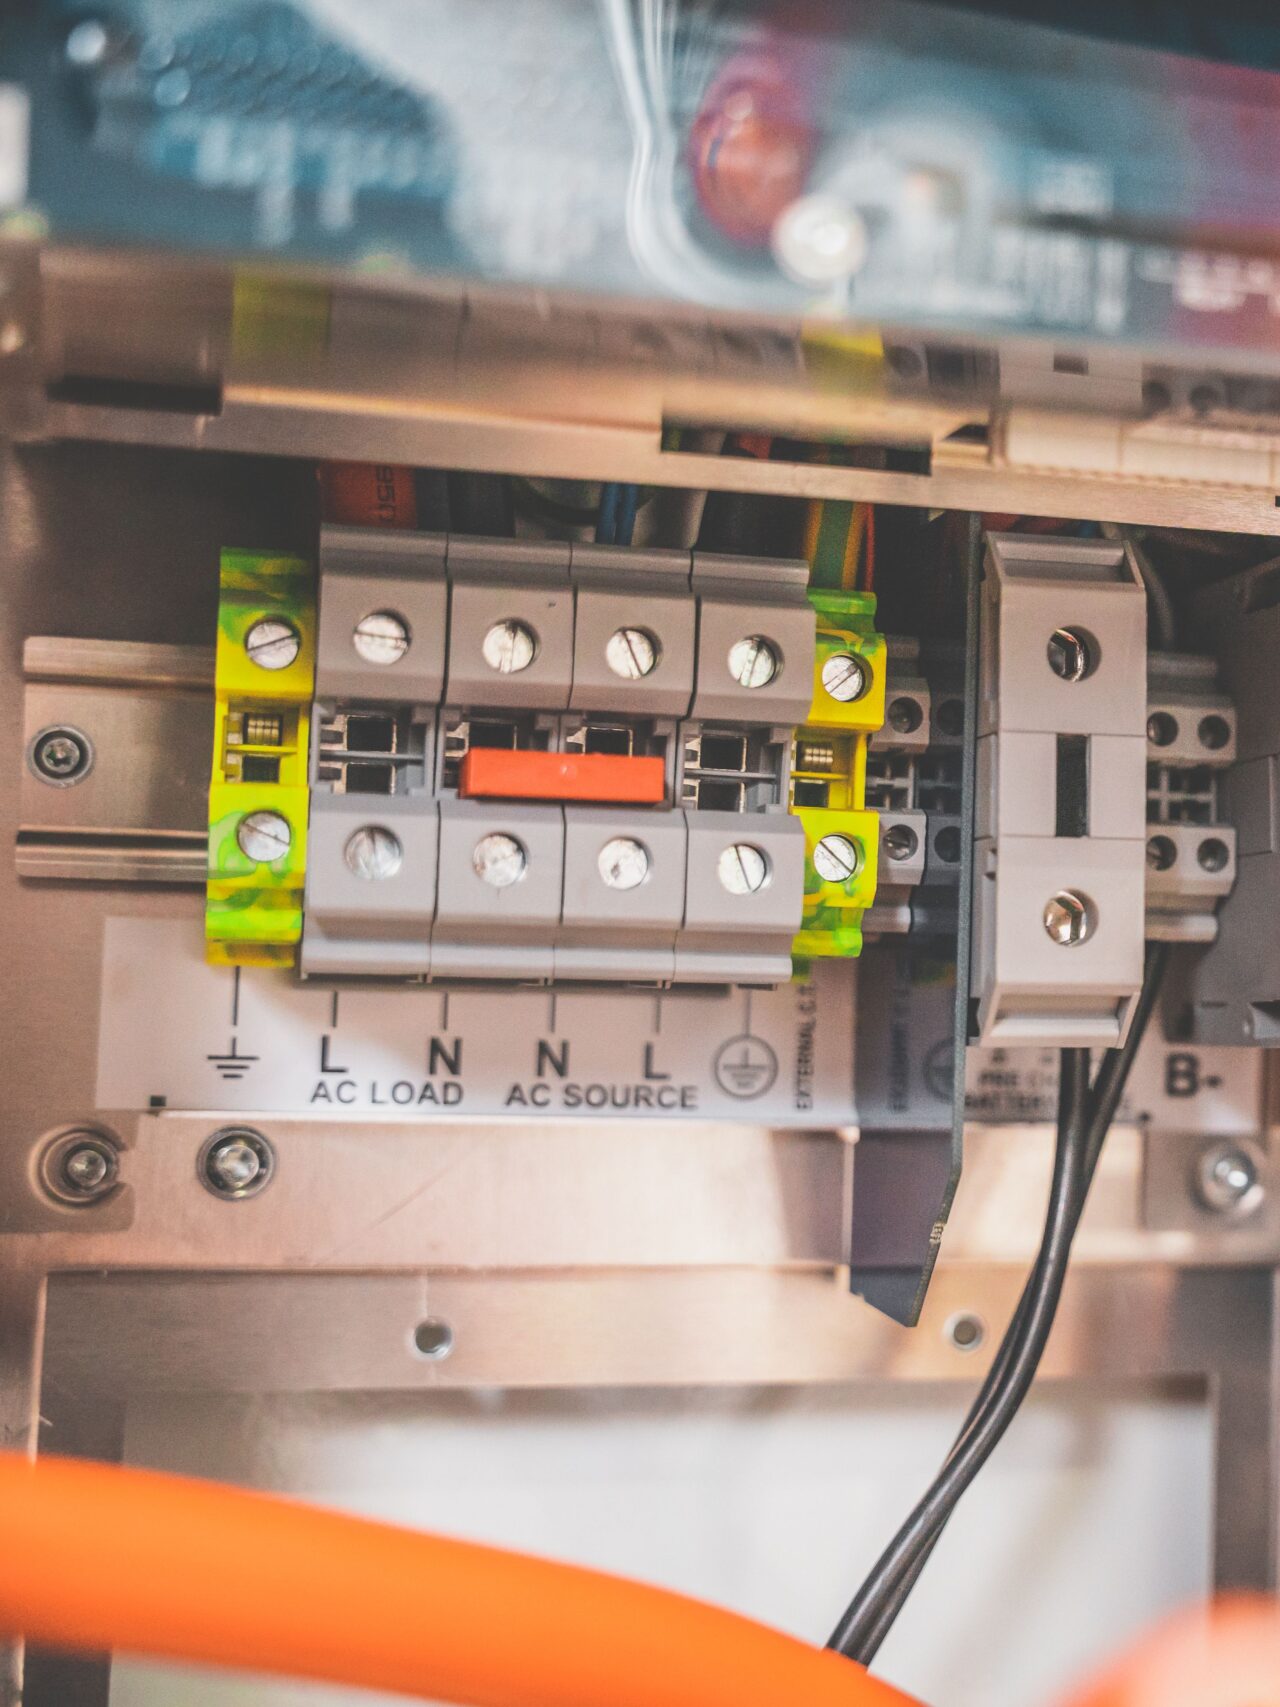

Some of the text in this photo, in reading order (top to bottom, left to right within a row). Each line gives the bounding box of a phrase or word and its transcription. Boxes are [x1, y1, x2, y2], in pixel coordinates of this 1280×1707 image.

[321, 1034, 463, 1075] L N
[536, 1039, 671, 1080] N L
[310, 1080, 464, 1105] AC LOAD
[505, 1083, 699, 1110] AC SOURCE
